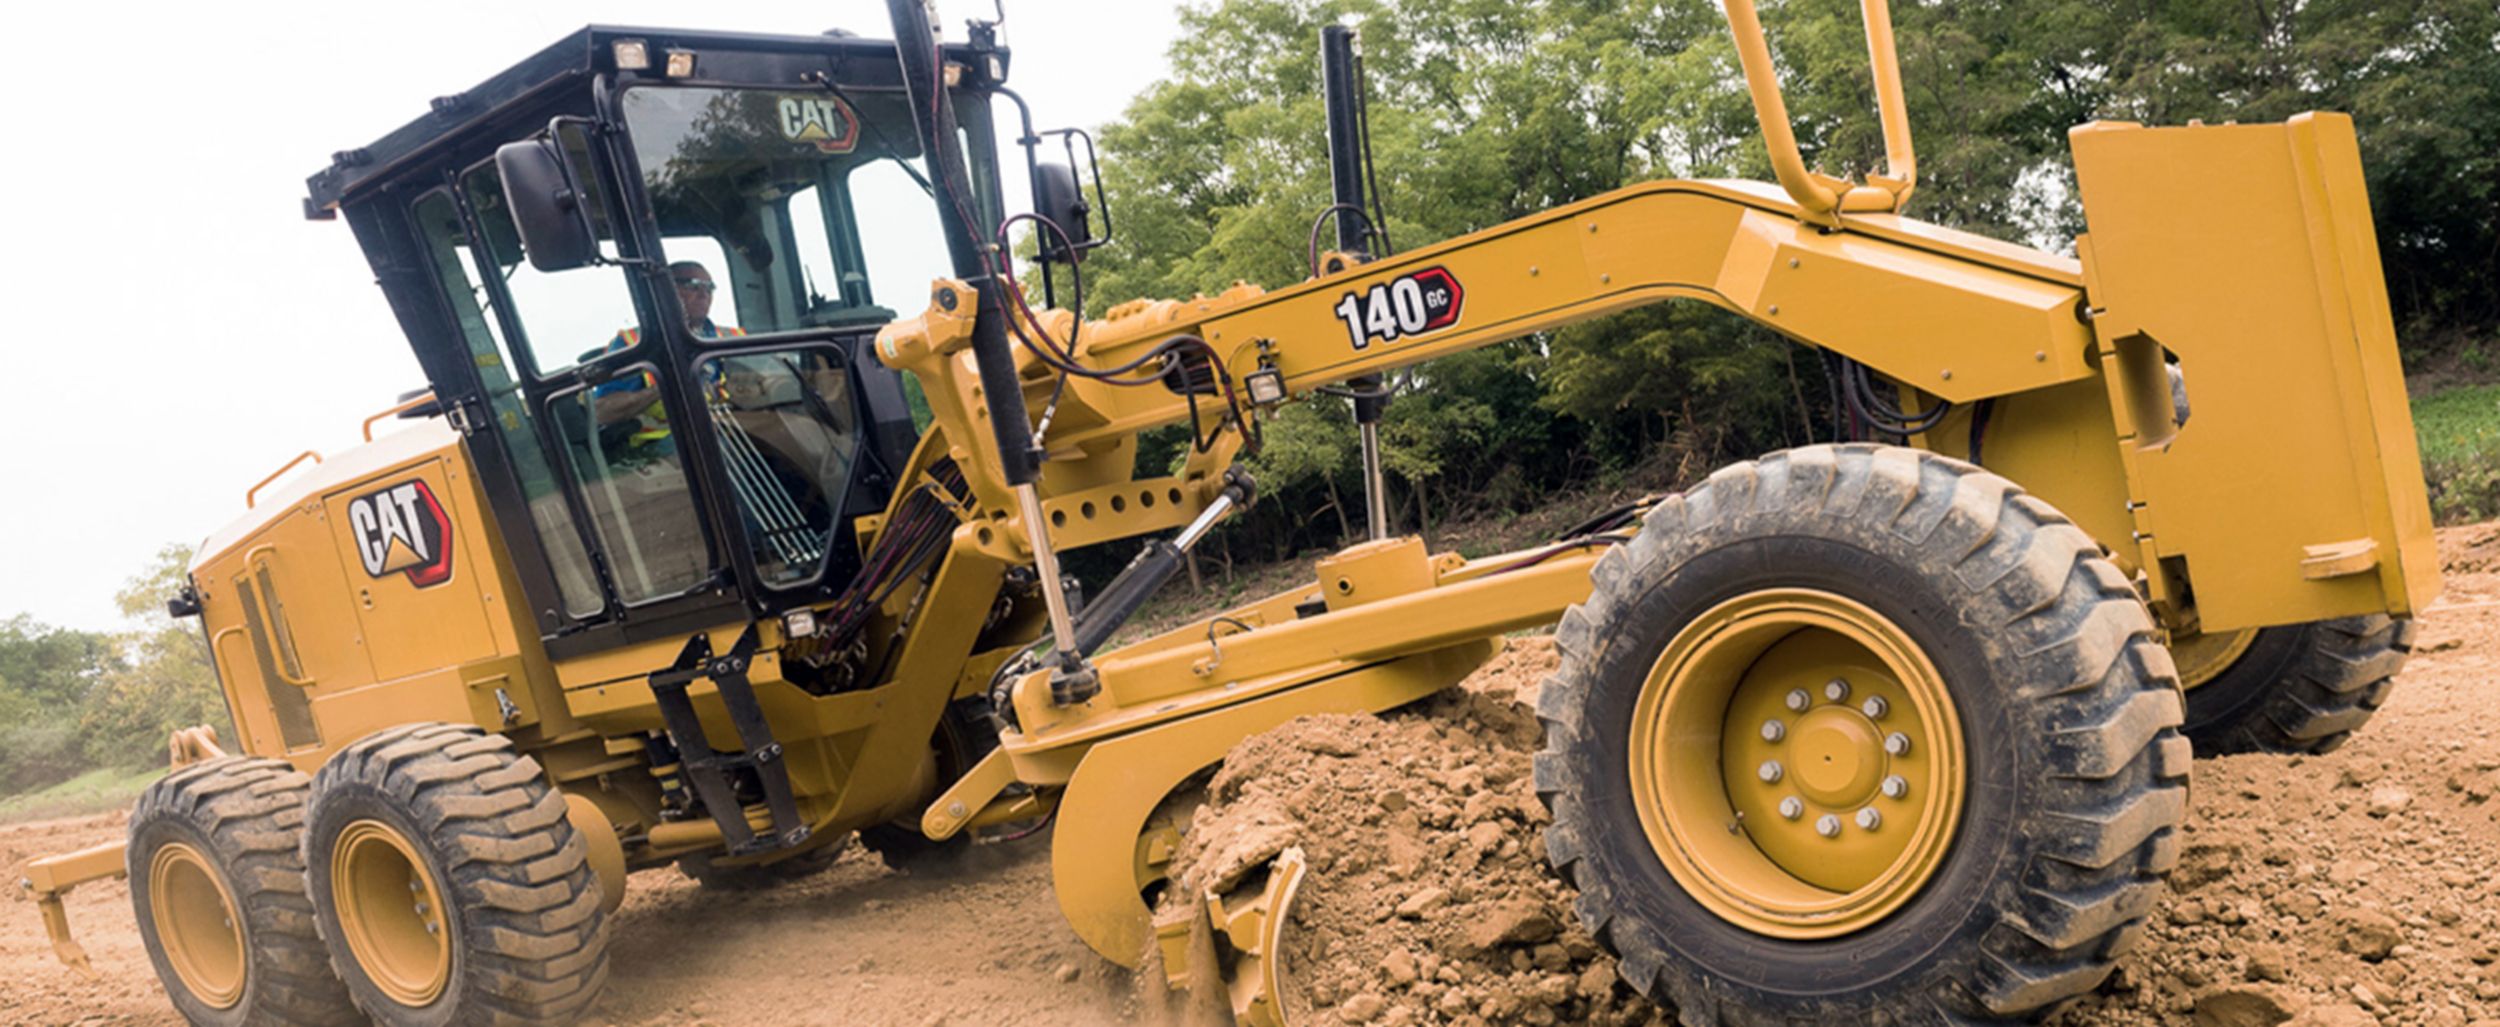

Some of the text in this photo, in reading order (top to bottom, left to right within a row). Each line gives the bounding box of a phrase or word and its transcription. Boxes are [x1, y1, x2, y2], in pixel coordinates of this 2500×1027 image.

[779, 98, 837, 139] CAT
[1336, 277, 1447, 347] 140 GC
[350, 482, 430, 575] CAT
